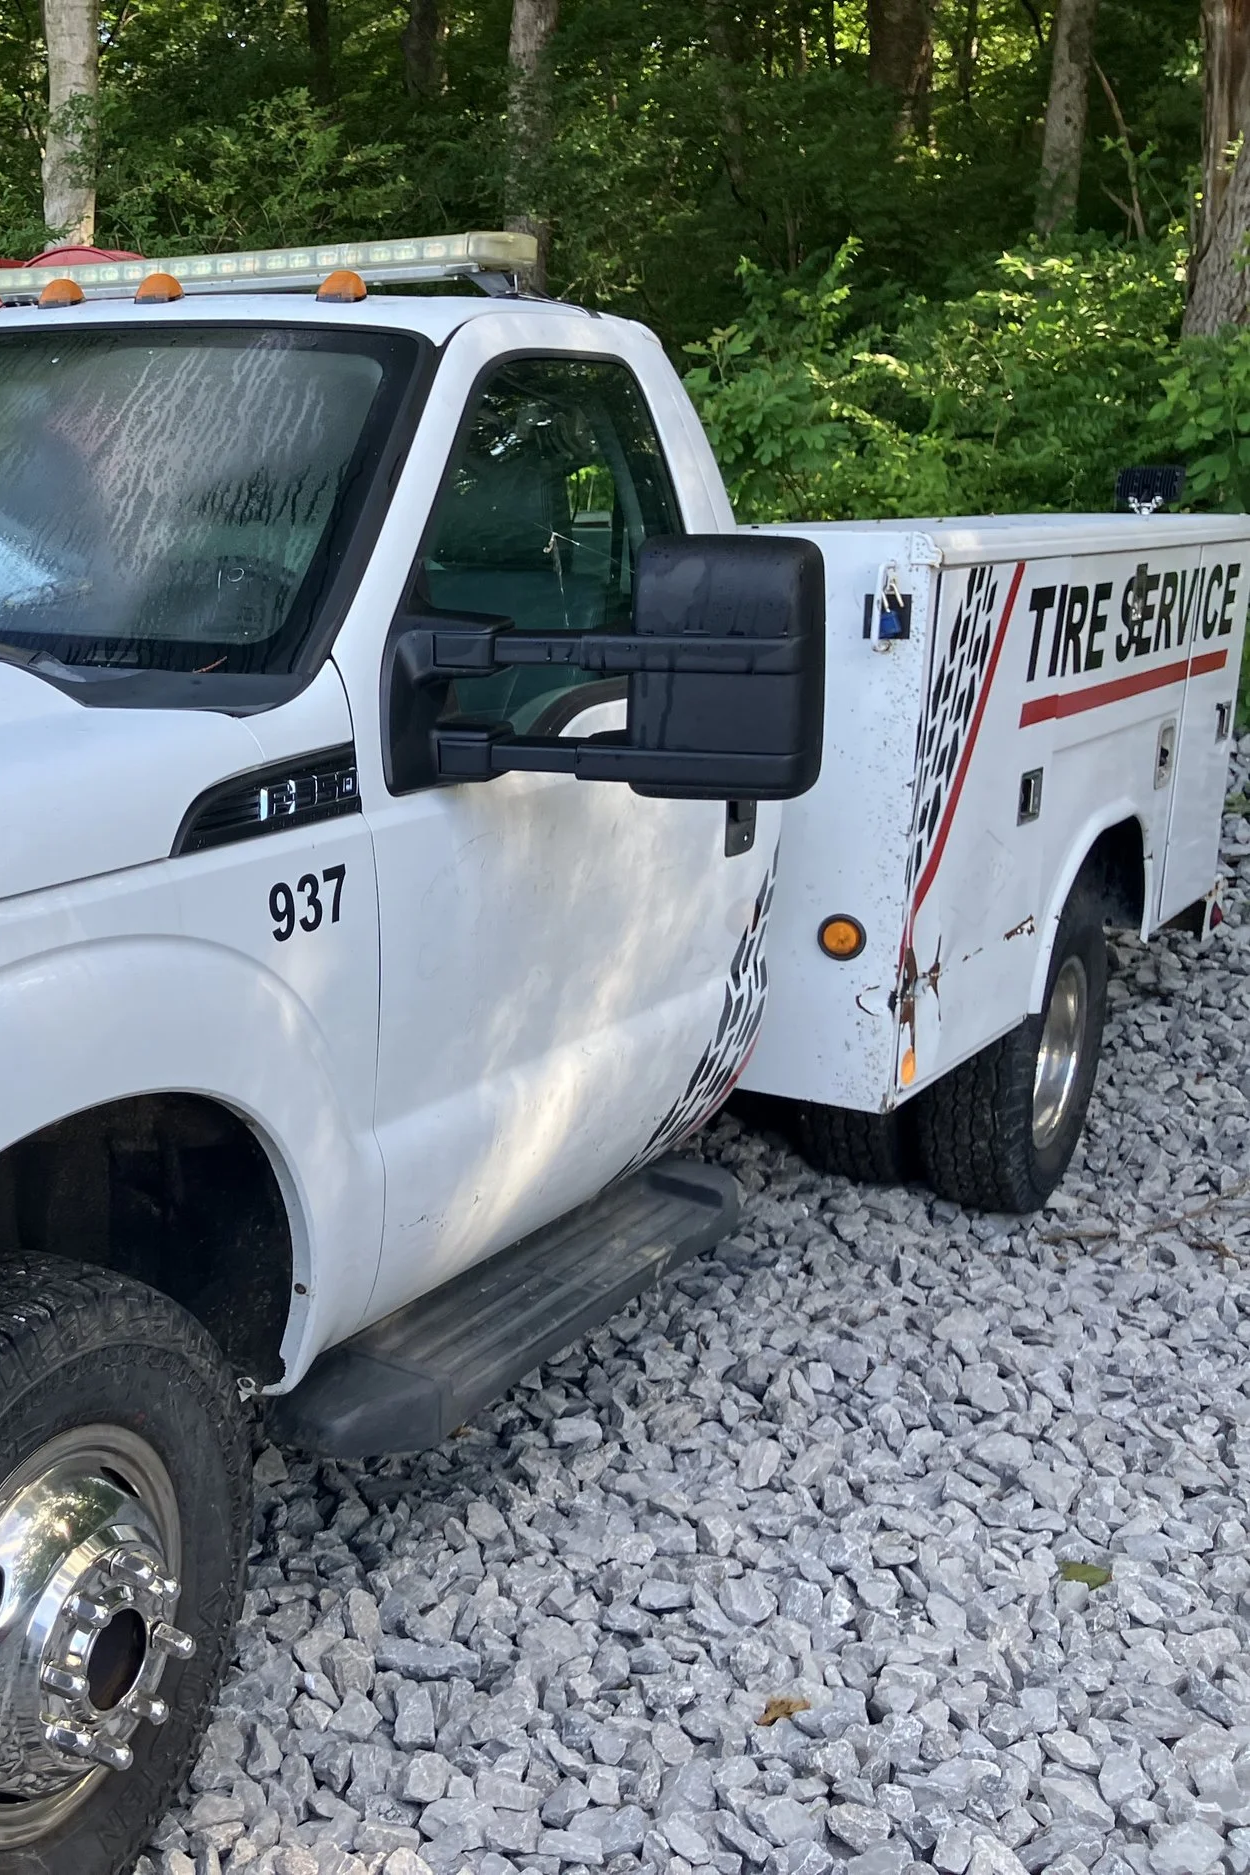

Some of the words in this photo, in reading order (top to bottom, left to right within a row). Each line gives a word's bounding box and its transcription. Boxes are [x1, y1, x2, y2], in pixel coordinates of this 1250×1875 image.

[1026, 581, 1113, 683] TIRE
[1115, 563, 1241, 662] SERVICE
[268, 863, 347, 942] 937
